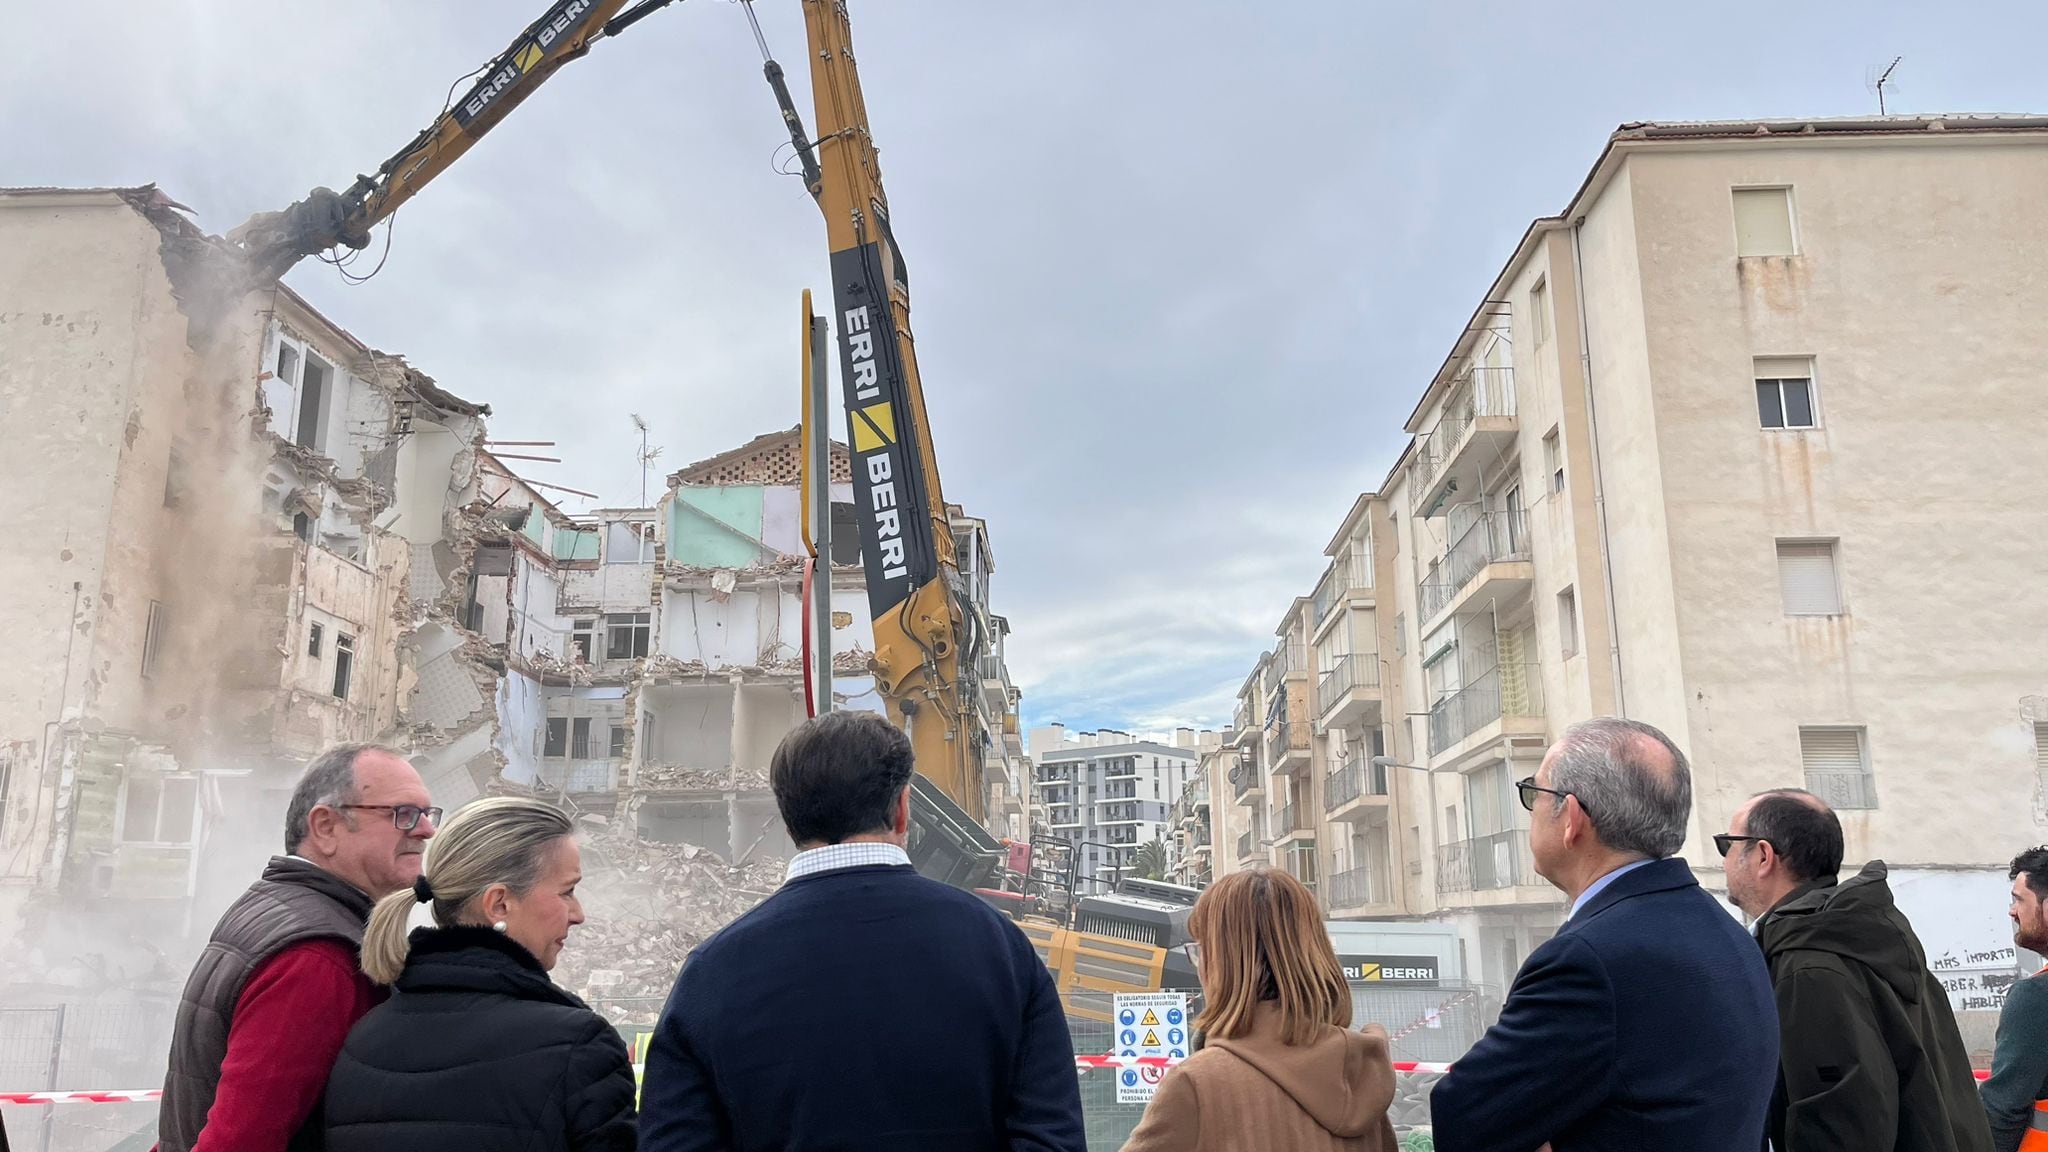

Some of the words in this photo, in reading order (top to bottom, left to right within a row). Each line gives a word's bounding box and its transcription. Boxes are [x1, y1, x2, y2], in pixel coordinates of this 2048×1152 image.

[465, 64, 516, 117] ERRI
[845, 305, 880, 400] ERRI
[867, 452, 908, 580] BERRI
[1934, 951, 1960, 969] MÁS
[1343, 967, 1359, 978] RI
[1382, 968, 1433, 978] BERRI
[1942, 978, 1977, 992] ABER
